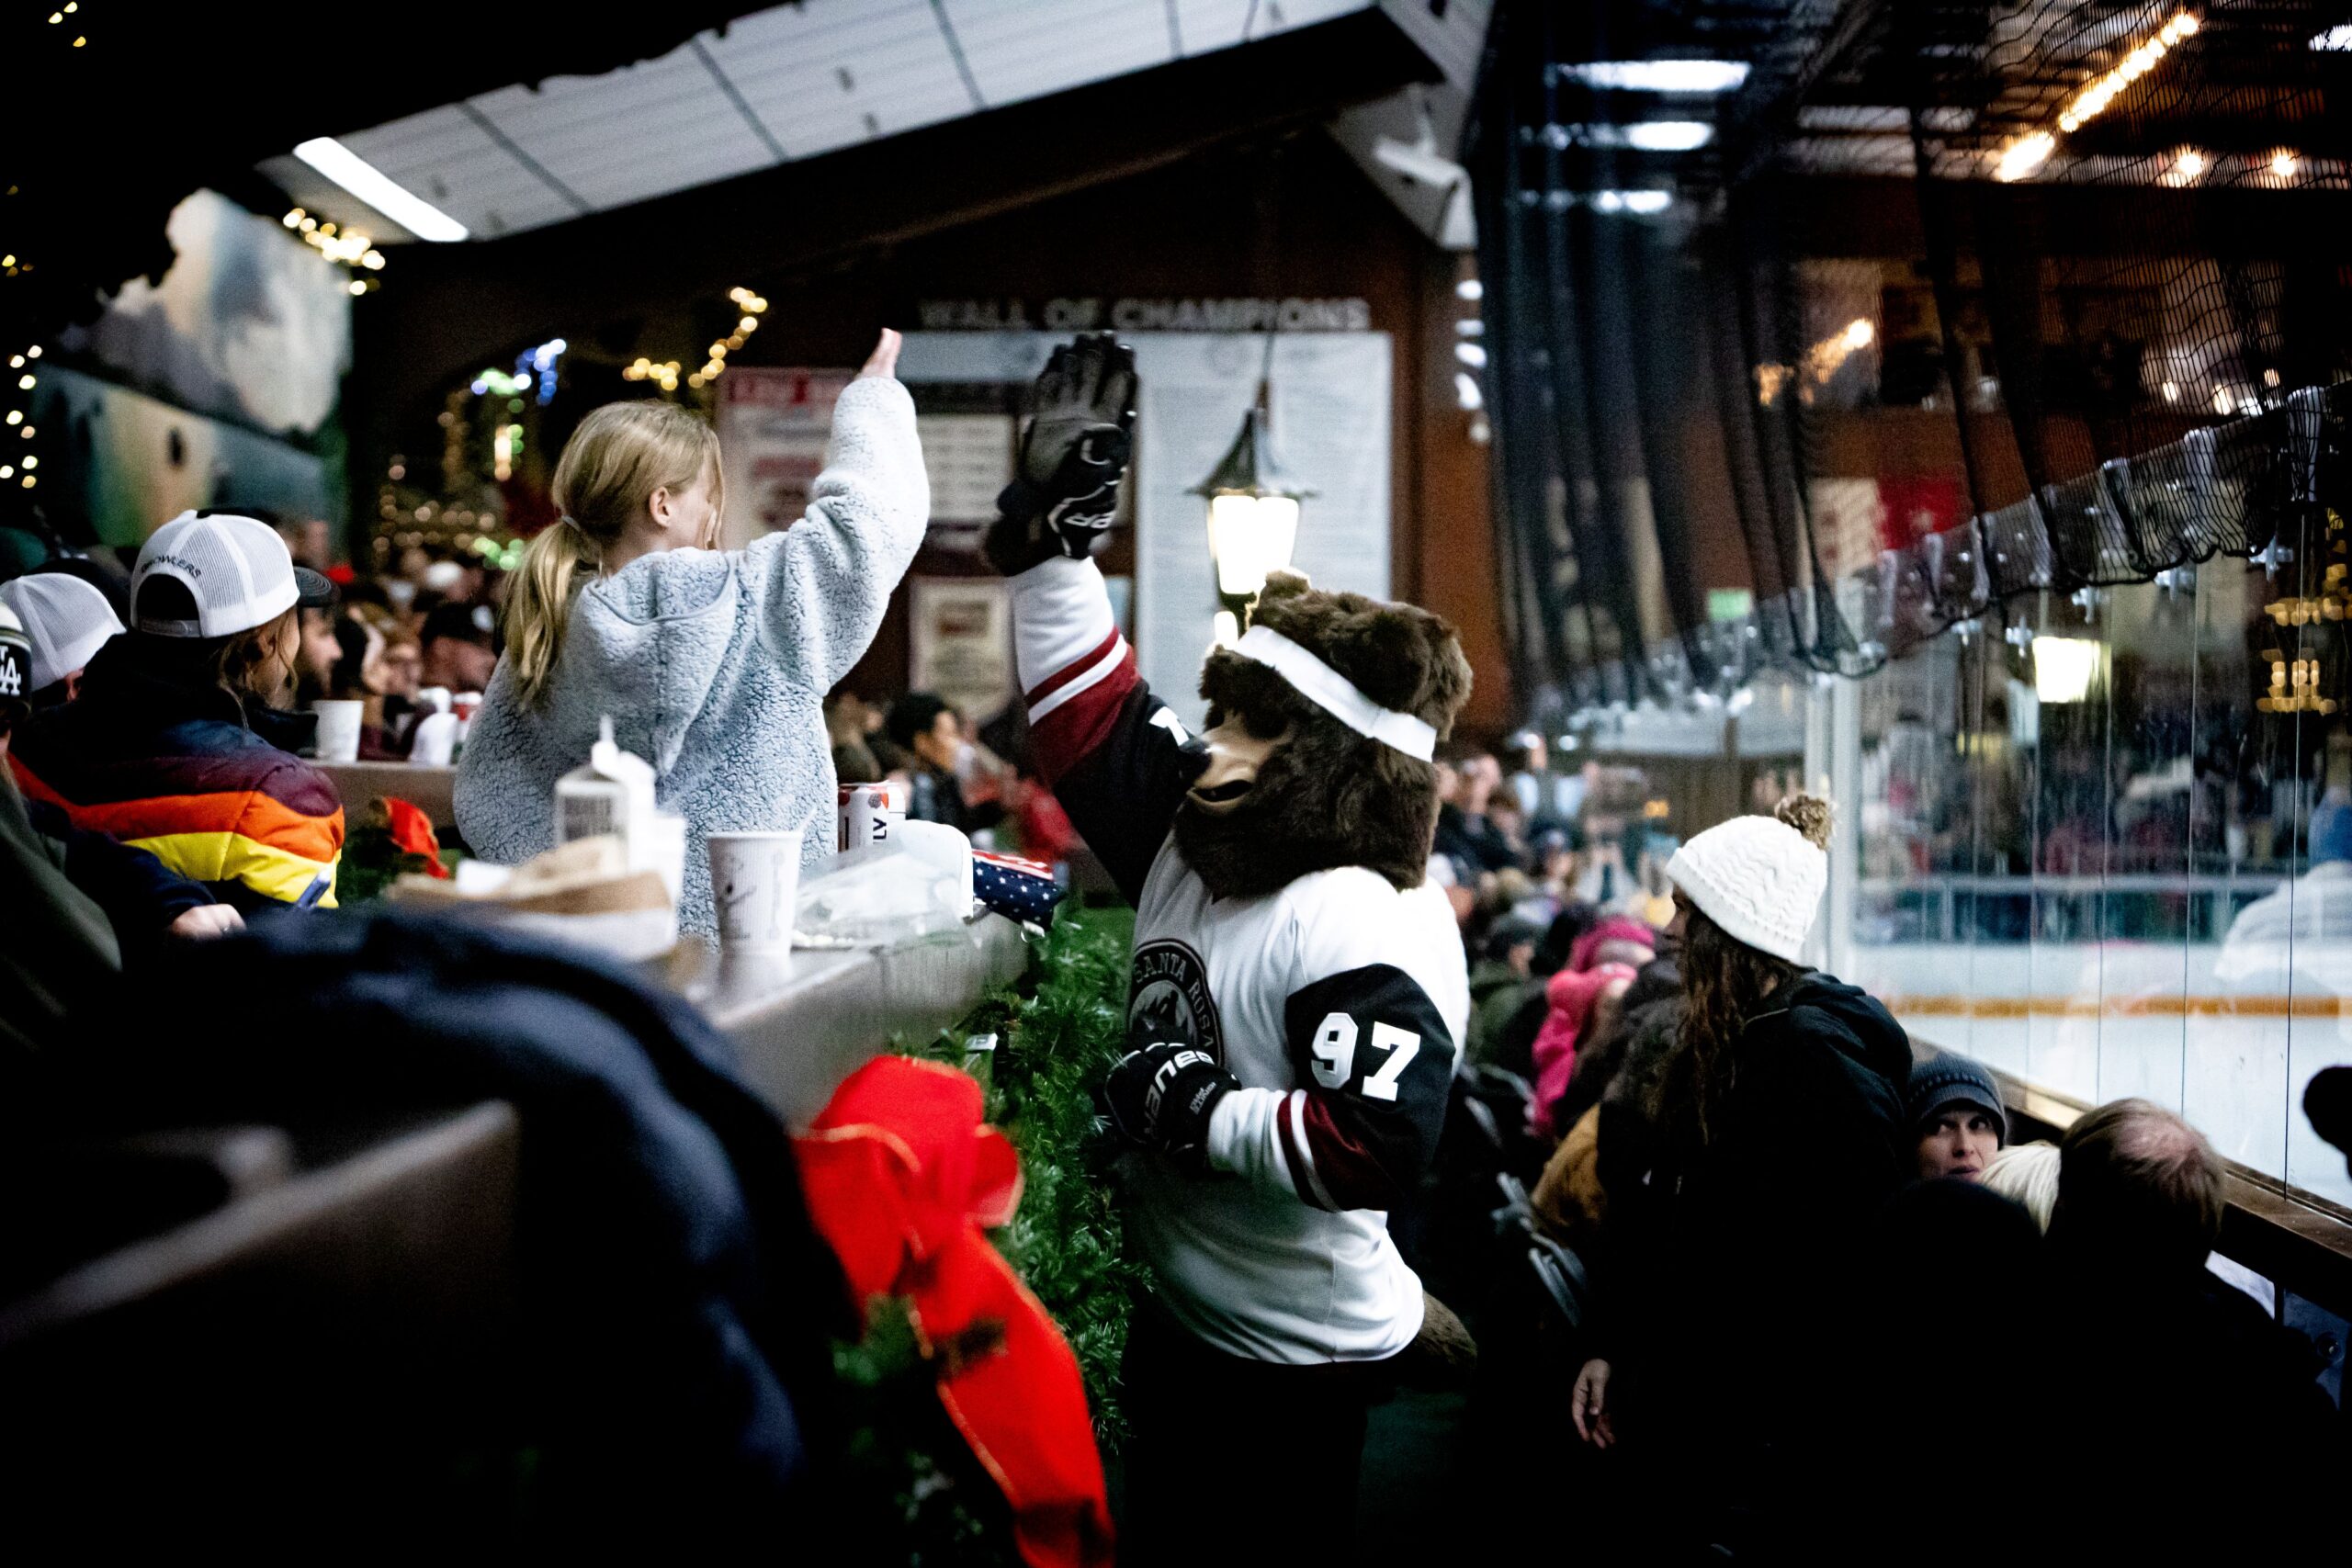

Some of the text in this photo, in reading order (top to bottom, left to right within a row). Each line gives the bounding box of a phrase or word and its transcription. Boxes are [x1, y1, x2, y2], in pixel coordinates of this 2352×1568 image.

[1044, 298, 1102, 328] OF
[1112, 297, 1370, 329] CHAMPIONS
[872, 817, 888, 844] LY
[1134, 953, 1214, 1047] SANTA ROSA
[1310, 1011, 1421, 1101] 97
